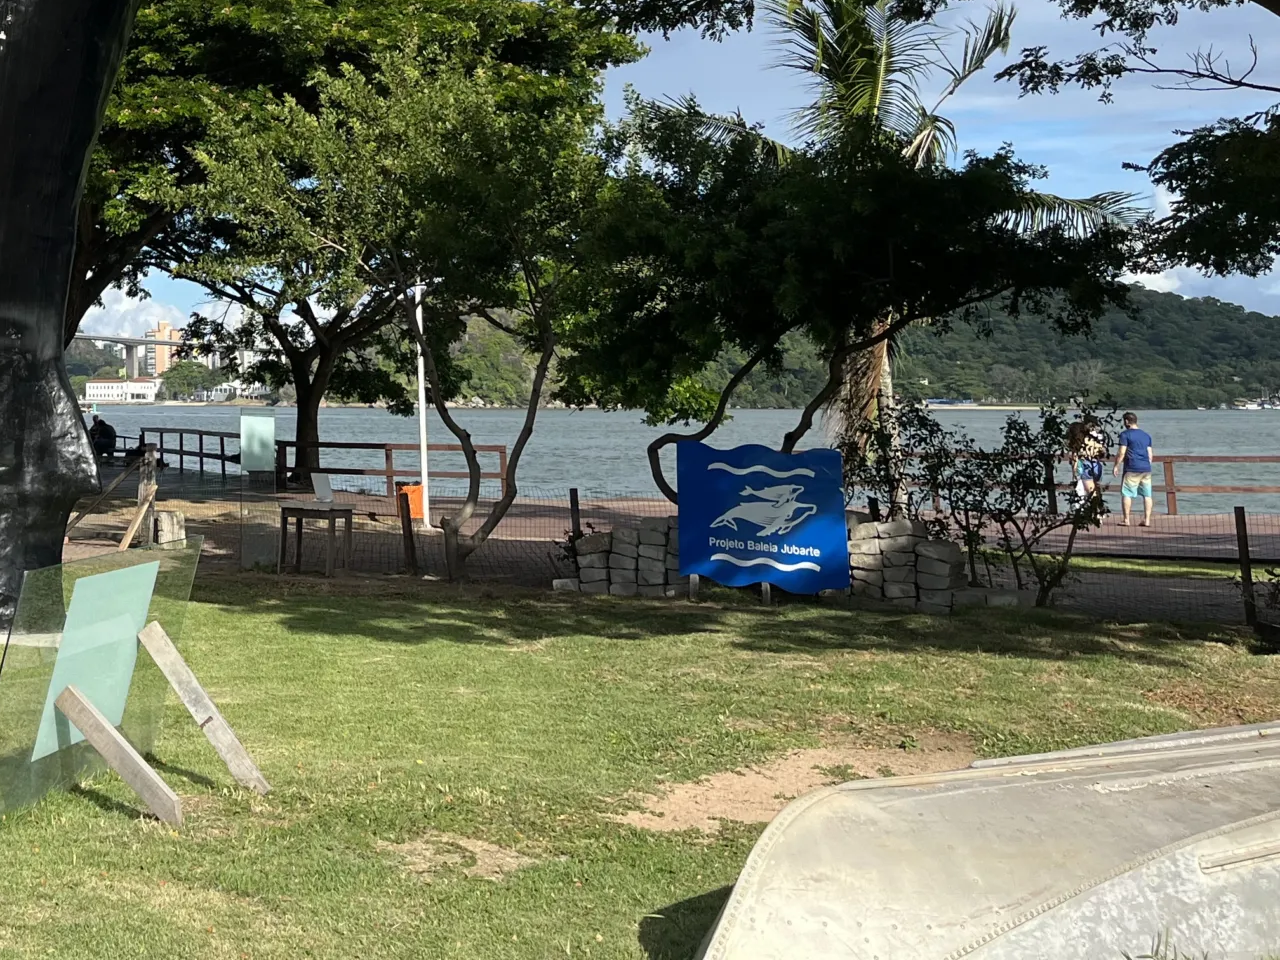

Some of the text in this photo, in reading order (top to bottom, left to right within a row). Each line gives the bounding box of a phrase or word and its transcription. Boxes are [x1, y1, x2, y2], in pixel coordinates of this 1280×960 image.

[709, 537, 820, 557] Projeto Baleia Jubarte
